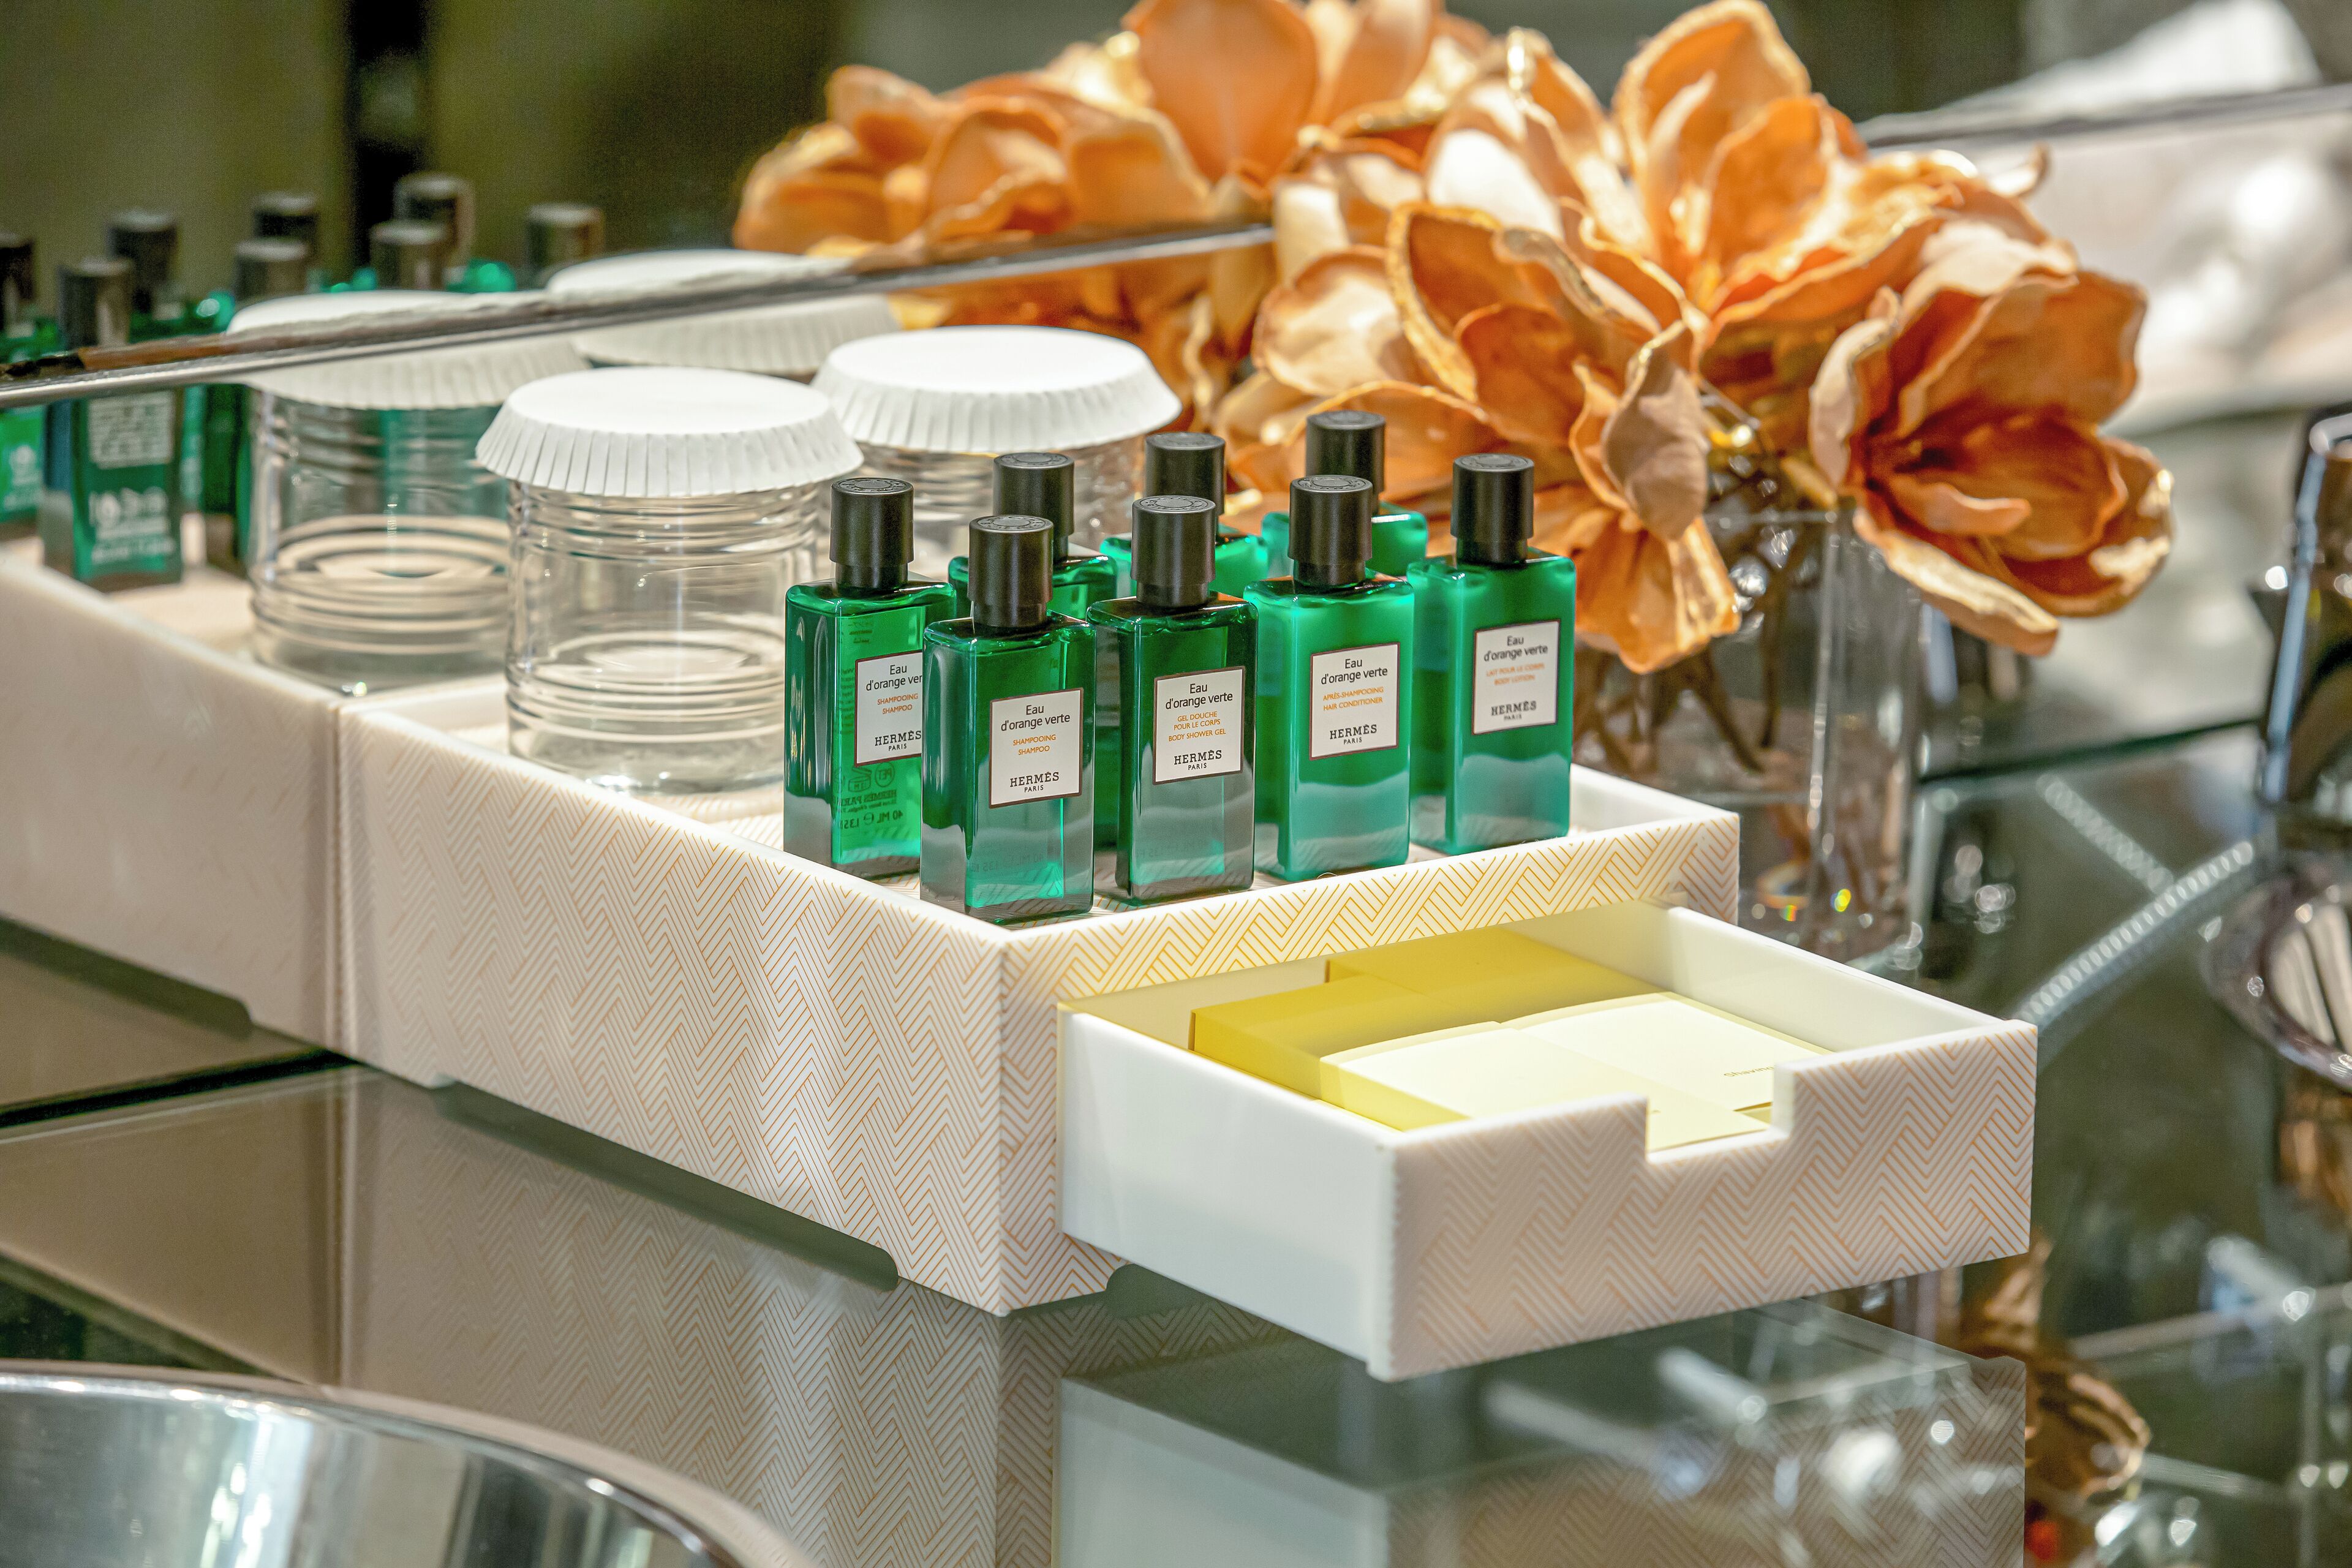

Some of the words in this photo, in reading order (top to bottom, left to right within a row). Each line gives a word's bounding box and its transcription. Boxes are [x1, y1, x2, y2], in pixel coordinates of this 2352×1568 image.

[1507, 635, 1524, 646] Eau
[1484, 648, 1522, 662] d'orange
[1525, 645, 1548, 656] verte
[1345, 658, 1363, 669] Eau
[890, 665, 907, 674] Eau
[1321, 672, 1361, 685] d'orange
[1363, 668, 1387, 678] verte
[866, 677, 905, 690] d'orange
[908, 675, 922, 684] ver
[1189, 684, 1207, 693] Eau
[878, 693, 918, 704] SHAMPOOING
[1166, 696, 1206, 709] d'orange
[1208, 692, 1233, 703] verte
[1339, 697, 1382, 708] CONDITIONER
[882, 704, 912, 714] SHAMPOO
[1026, 705, 1044, 715] Eau
[1190, 711, 1217, 720] DOUCHE
[1001, 717, 1042, 731] d'orange
[1045, 714, 1070, 725] verte
[1174, 722, 1190, 731] POUR
[1169, 733, 1185, 742] BODY
[1186, 730, 1213, 739] SHOWER
[1330, 724, 1377, 739] HERMÈS
[875, 731, 921, 746] HERMÈS
[1013, 734, 1056, 745] SHAMPOOING
[1019, 745, 1050, 755] SHAMPOO
[1174, 750, 1222, 765] HERMÈS
[1010, 771, 1059, 787] HERMÈS
